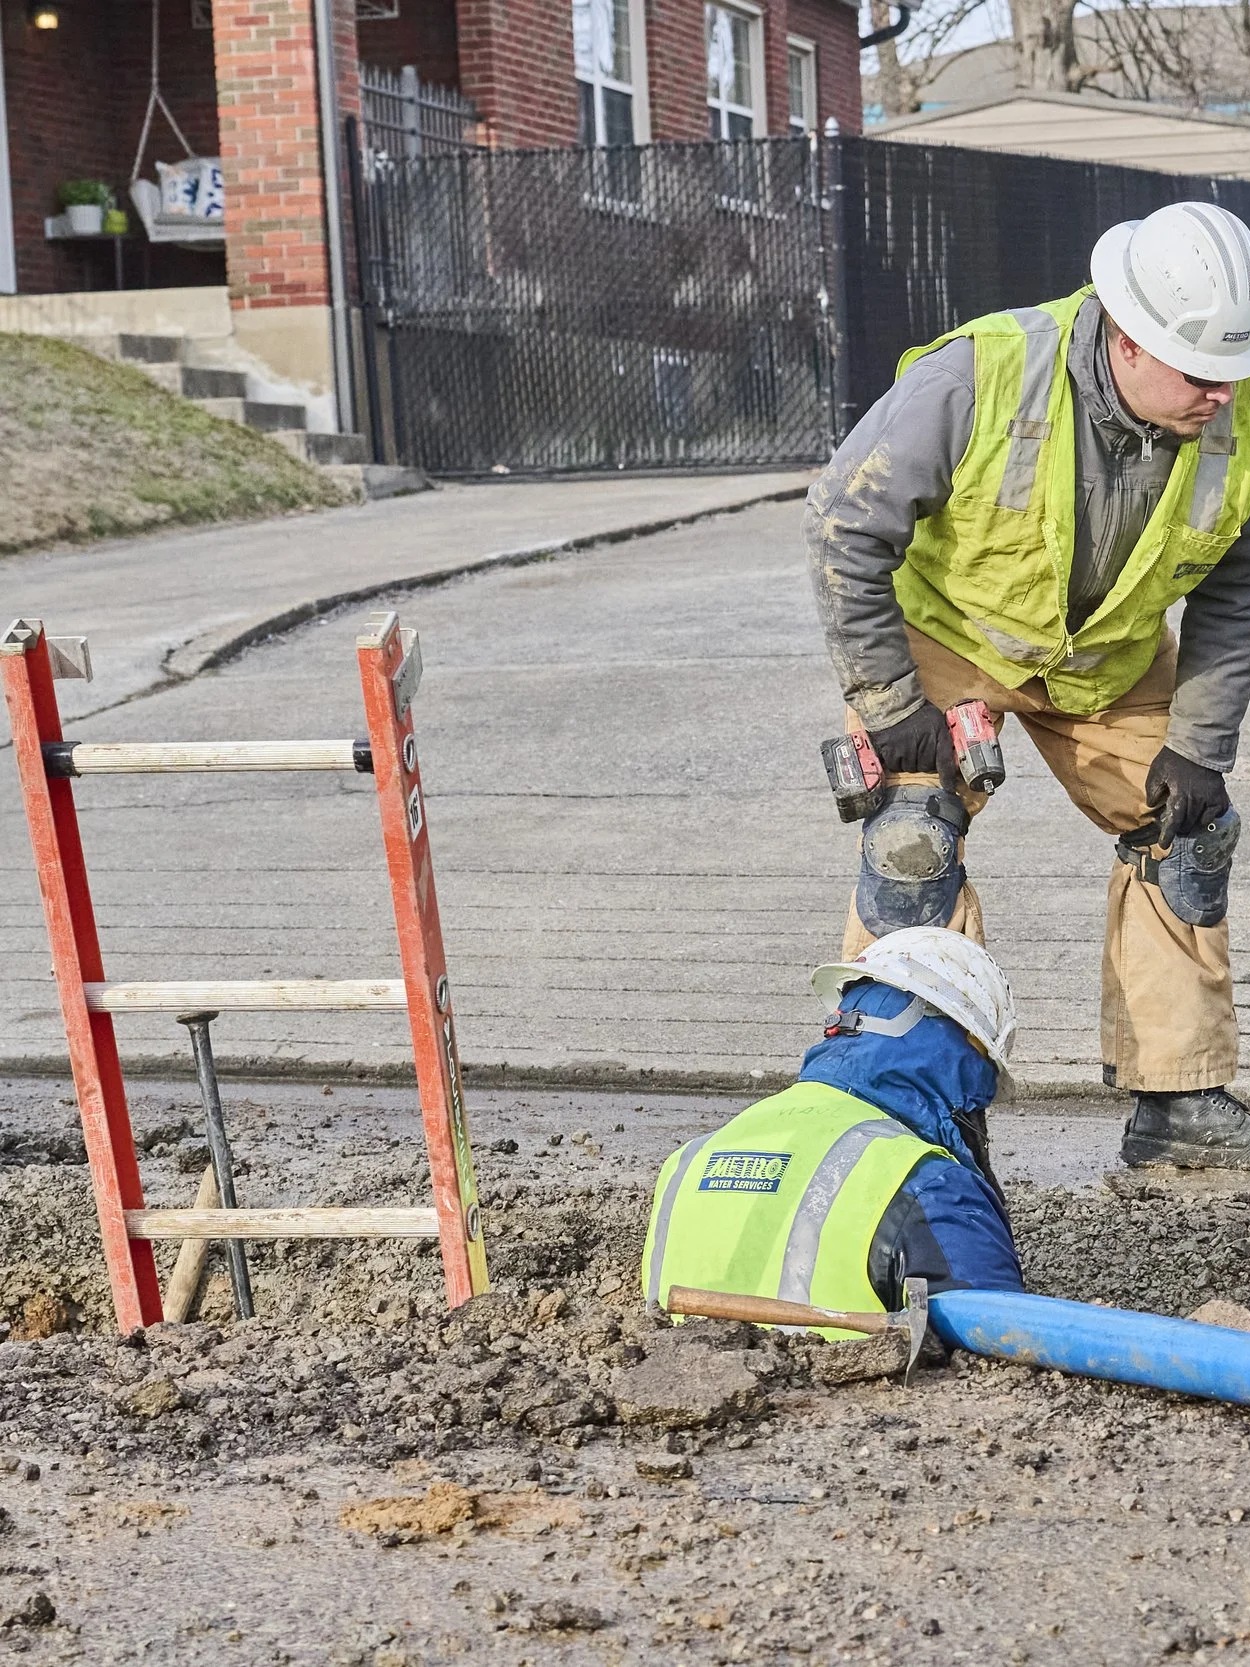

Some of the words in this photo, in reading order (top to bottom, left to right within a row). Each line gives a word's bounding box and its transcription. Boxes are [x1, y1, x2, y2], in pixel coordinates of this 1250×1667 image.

[1224, 333, 1249, 341] METRO
[706, 1156, 782, 1179] METRO
[708, 1180, 731, 1189] WATER
[733, 1180, 774, 1190] SERVICES
